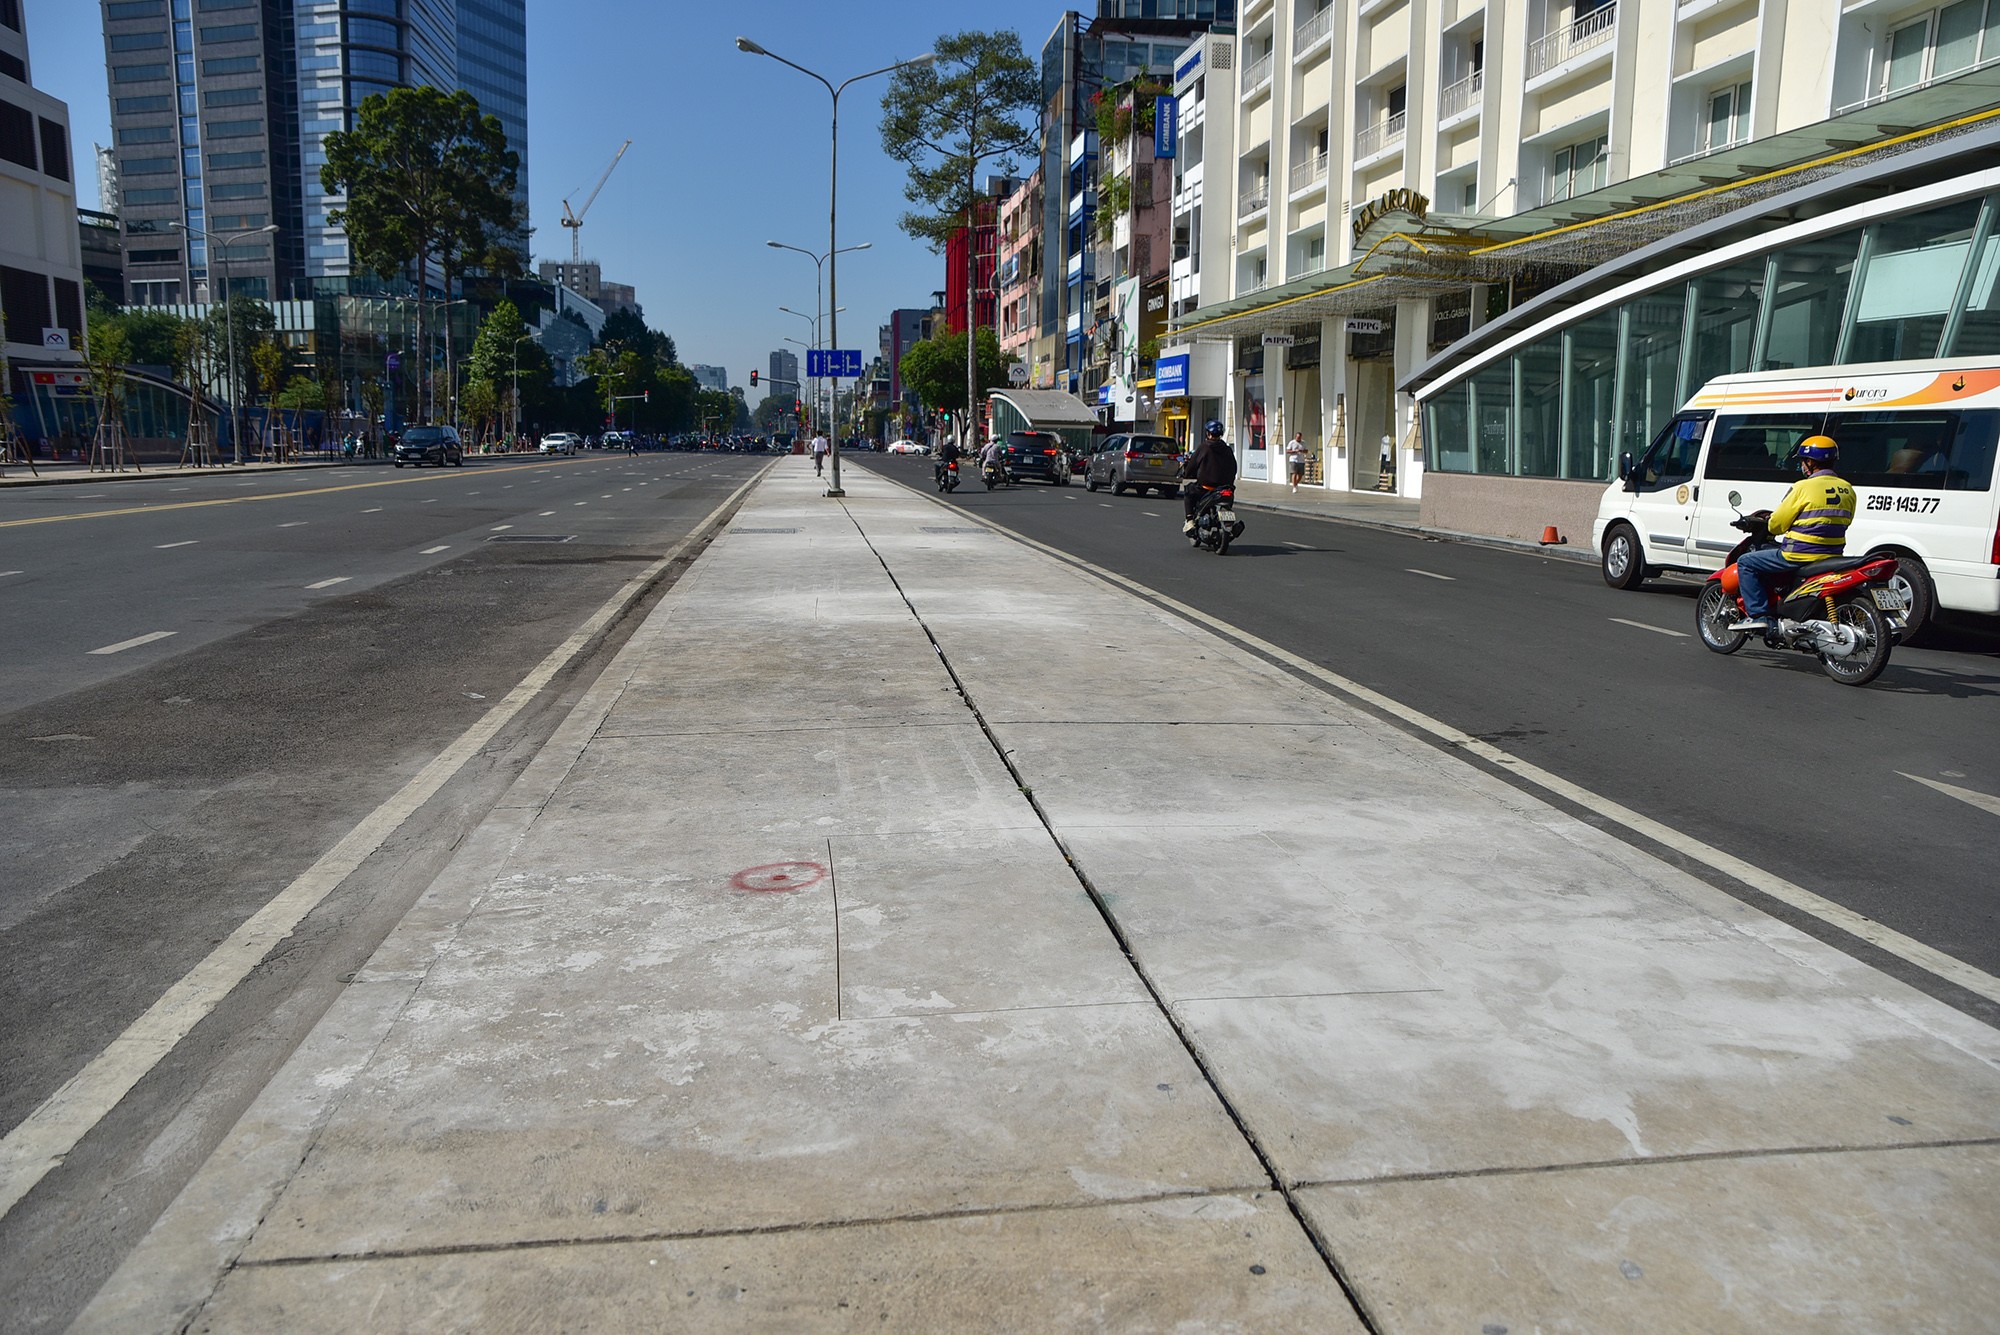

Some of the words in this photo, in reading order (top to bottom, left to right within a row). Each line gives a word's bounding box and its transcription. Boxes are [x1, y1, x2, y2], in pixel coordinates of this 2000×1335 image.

[1163, 102, 1171, 151] EXIMBANK
[1352, 200, 1377, 241] REX
[1380, 188, 1430, 221] ARCADE
[1357, 321, 1379, 331] IPPG
[1273, 336, 1293, 345] IPPG
[1158, 364, 1183, 379] EXIMBANK
[1837, 486, 1849, 494] be
